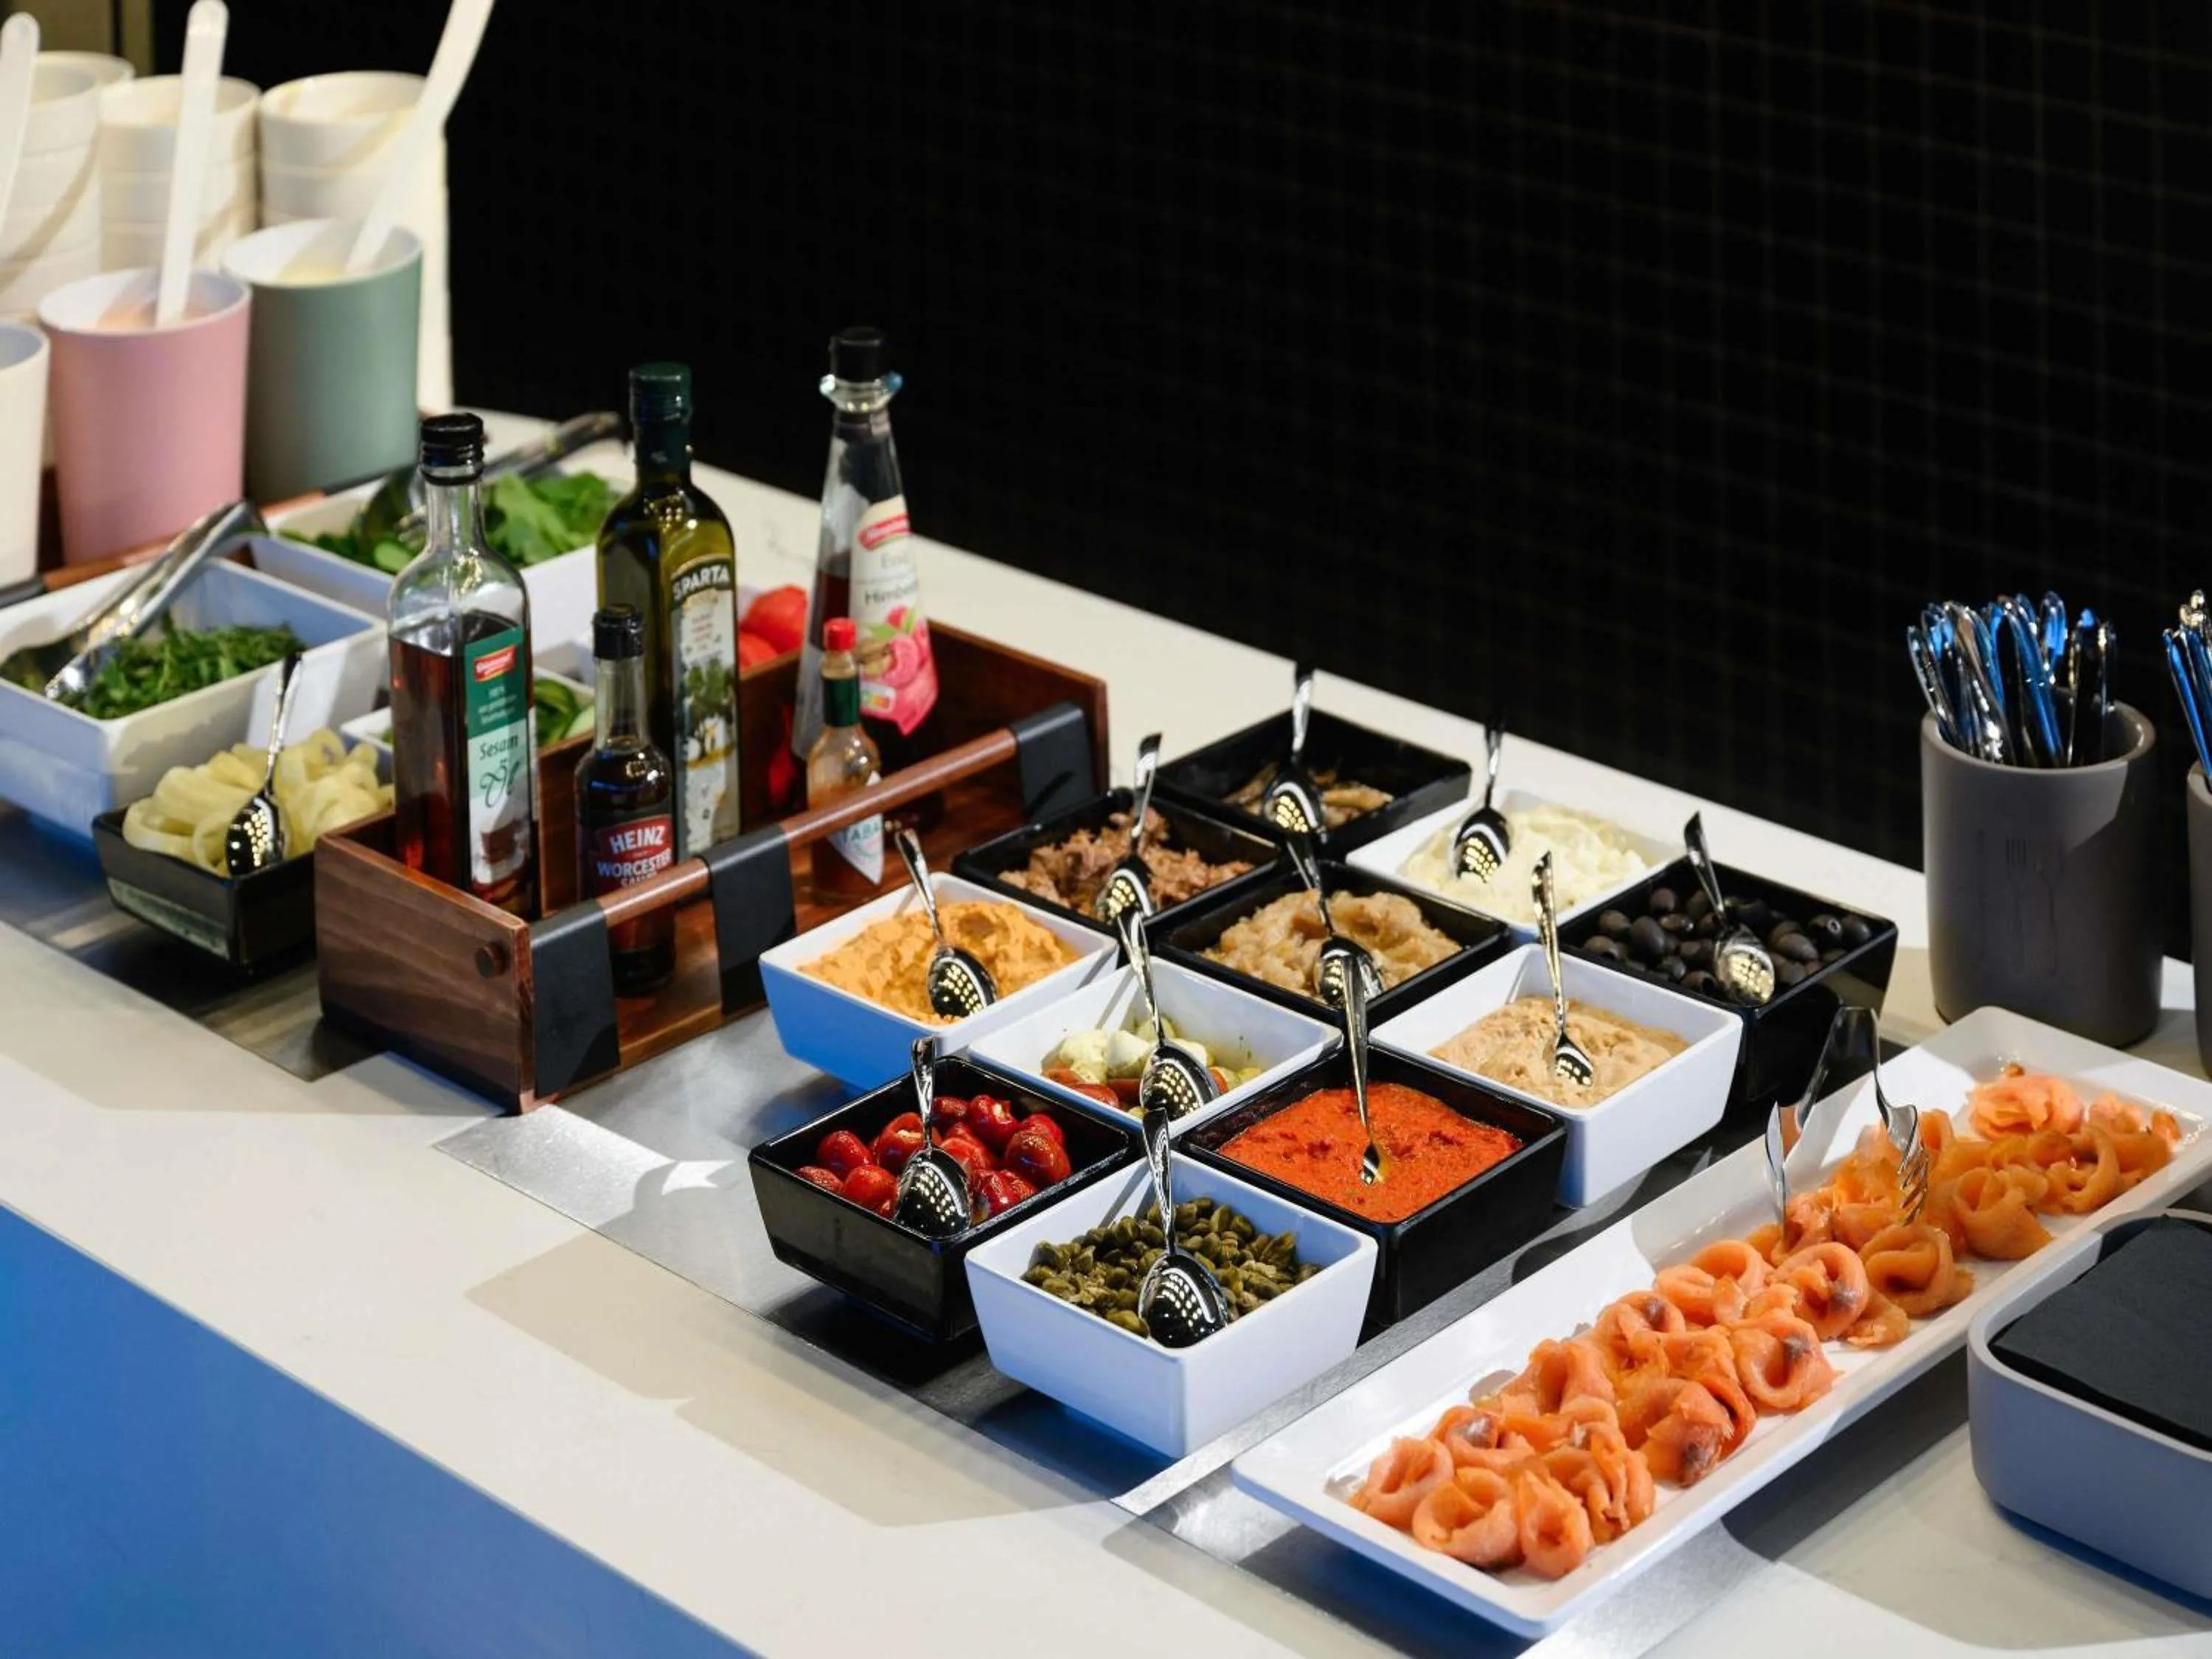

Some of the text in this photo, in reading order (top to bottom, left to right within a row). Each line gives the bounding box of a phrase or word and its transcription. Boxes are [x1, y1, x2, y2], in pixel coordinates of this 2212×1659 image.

[672, 564, 730, 601] SPARTA
[480, 734, 518, 760] Sesam
[479, 758, 520, 808] Öl
[609, 825, 666, 854] HEINZ
[597, 847, 672, 877] WORCESTER
